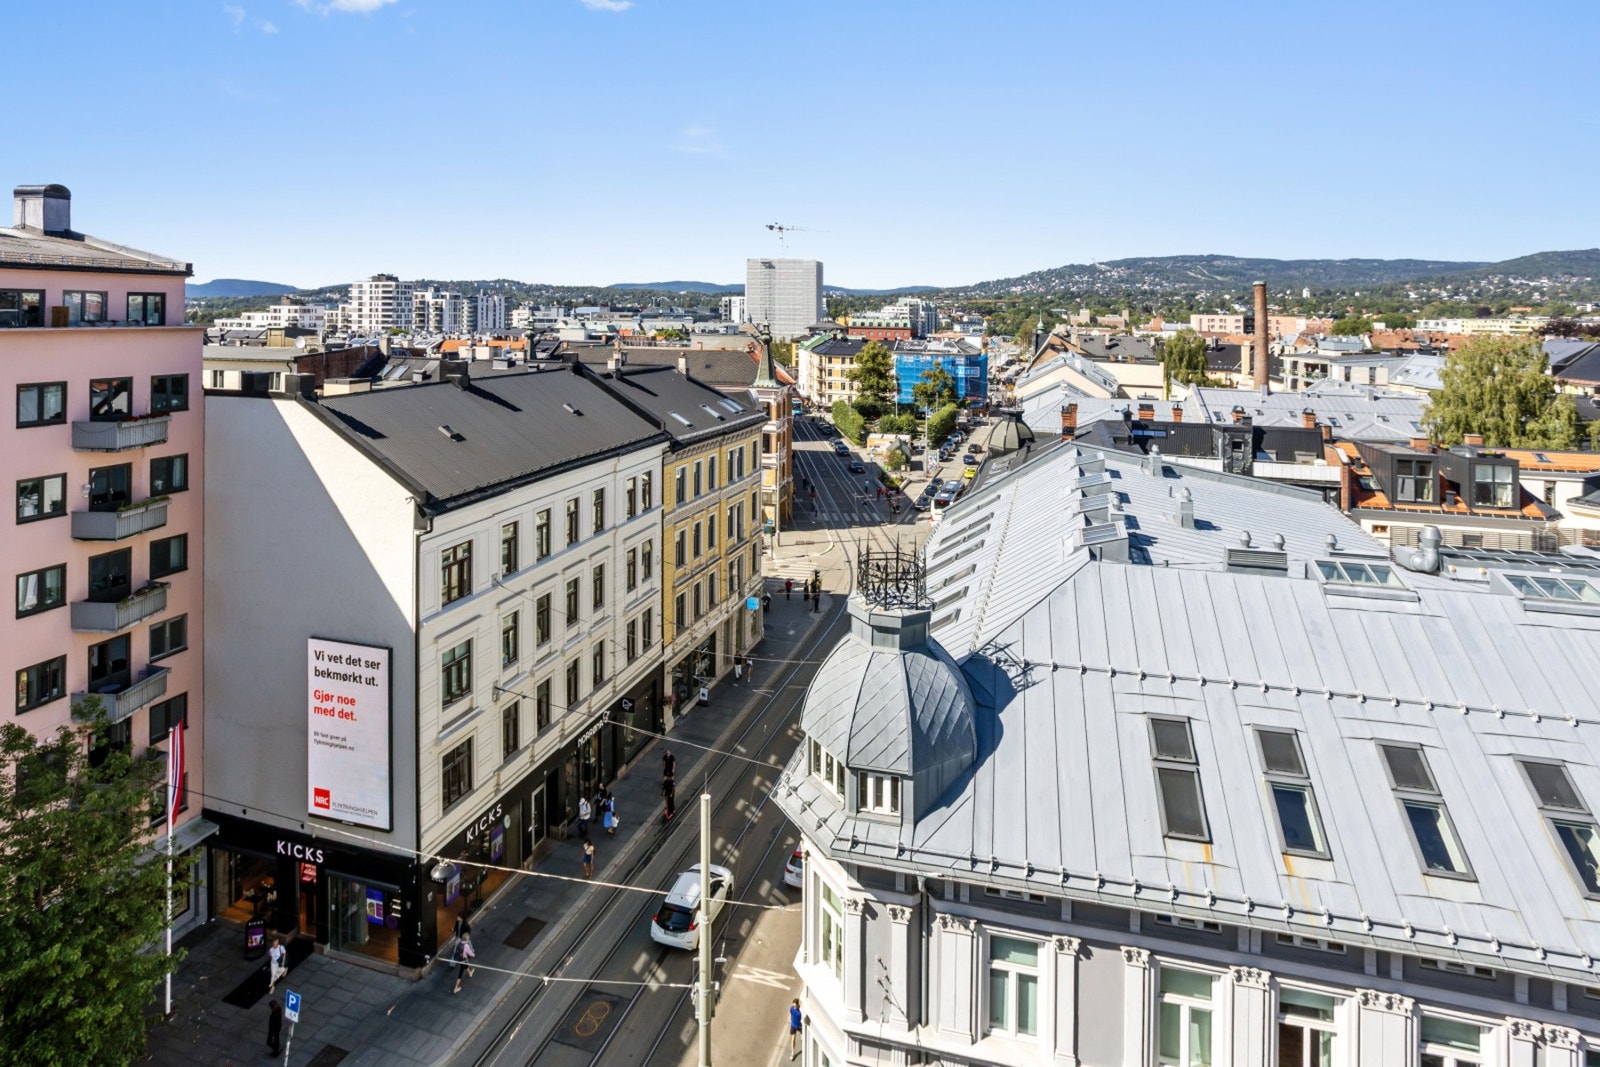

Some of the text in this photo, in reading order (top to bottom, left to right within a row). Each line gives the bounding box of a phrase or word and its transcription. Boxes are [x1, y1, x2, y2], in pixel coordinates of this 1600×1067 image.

[314, 650, 380, 670] Vi vet det ser
[314, 666, 378, 687] bekmørkt ut.
[314, 689, 356, 706] Gjør noe
[314, 706, 357, 721] med det.
[315, 796, 328, 806] NRC
[466, 803, 502, 844] KICKS
[277, 839, 324, 864] KICKS
[288, 994, 296, 1008] P
